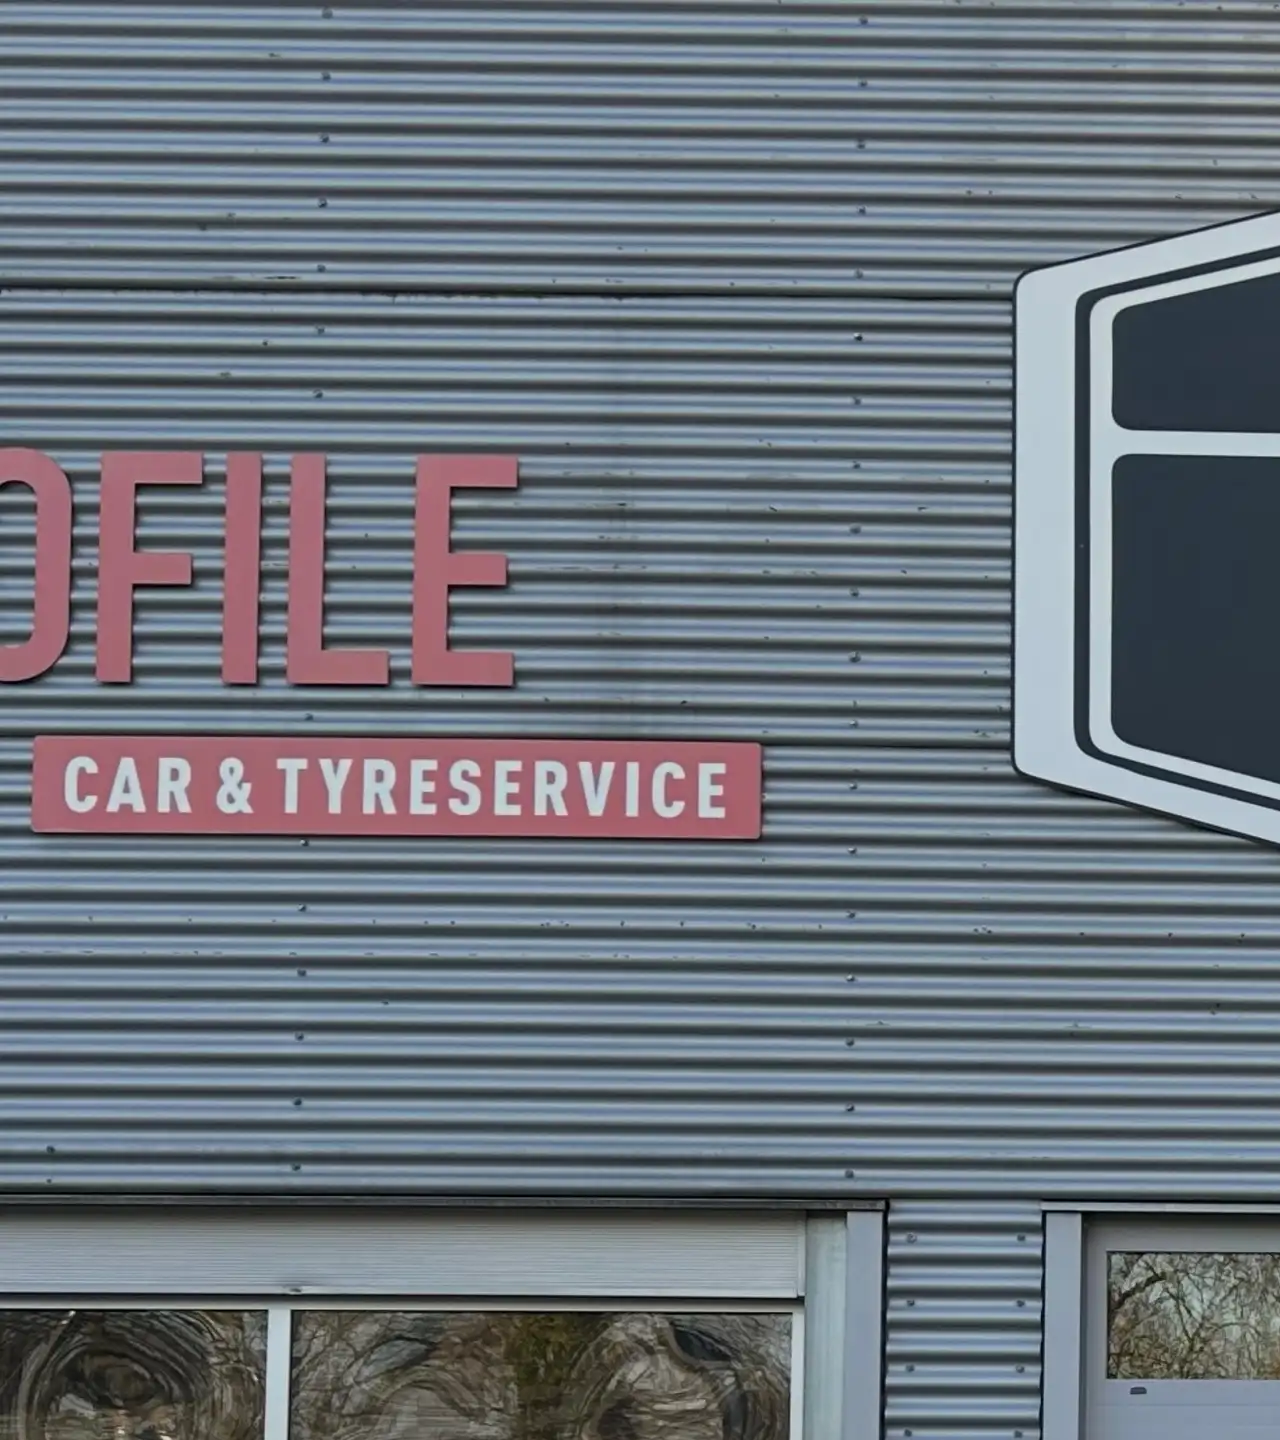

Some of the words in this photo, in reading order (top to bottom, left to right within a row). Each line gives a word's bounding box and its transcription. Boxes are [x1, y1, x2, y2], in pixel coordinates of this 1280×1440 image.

[64, 756, 192, 813] CAR
[216, 757, 253, 814] &
[277, 758, 727, 818] TYRESERVICE
